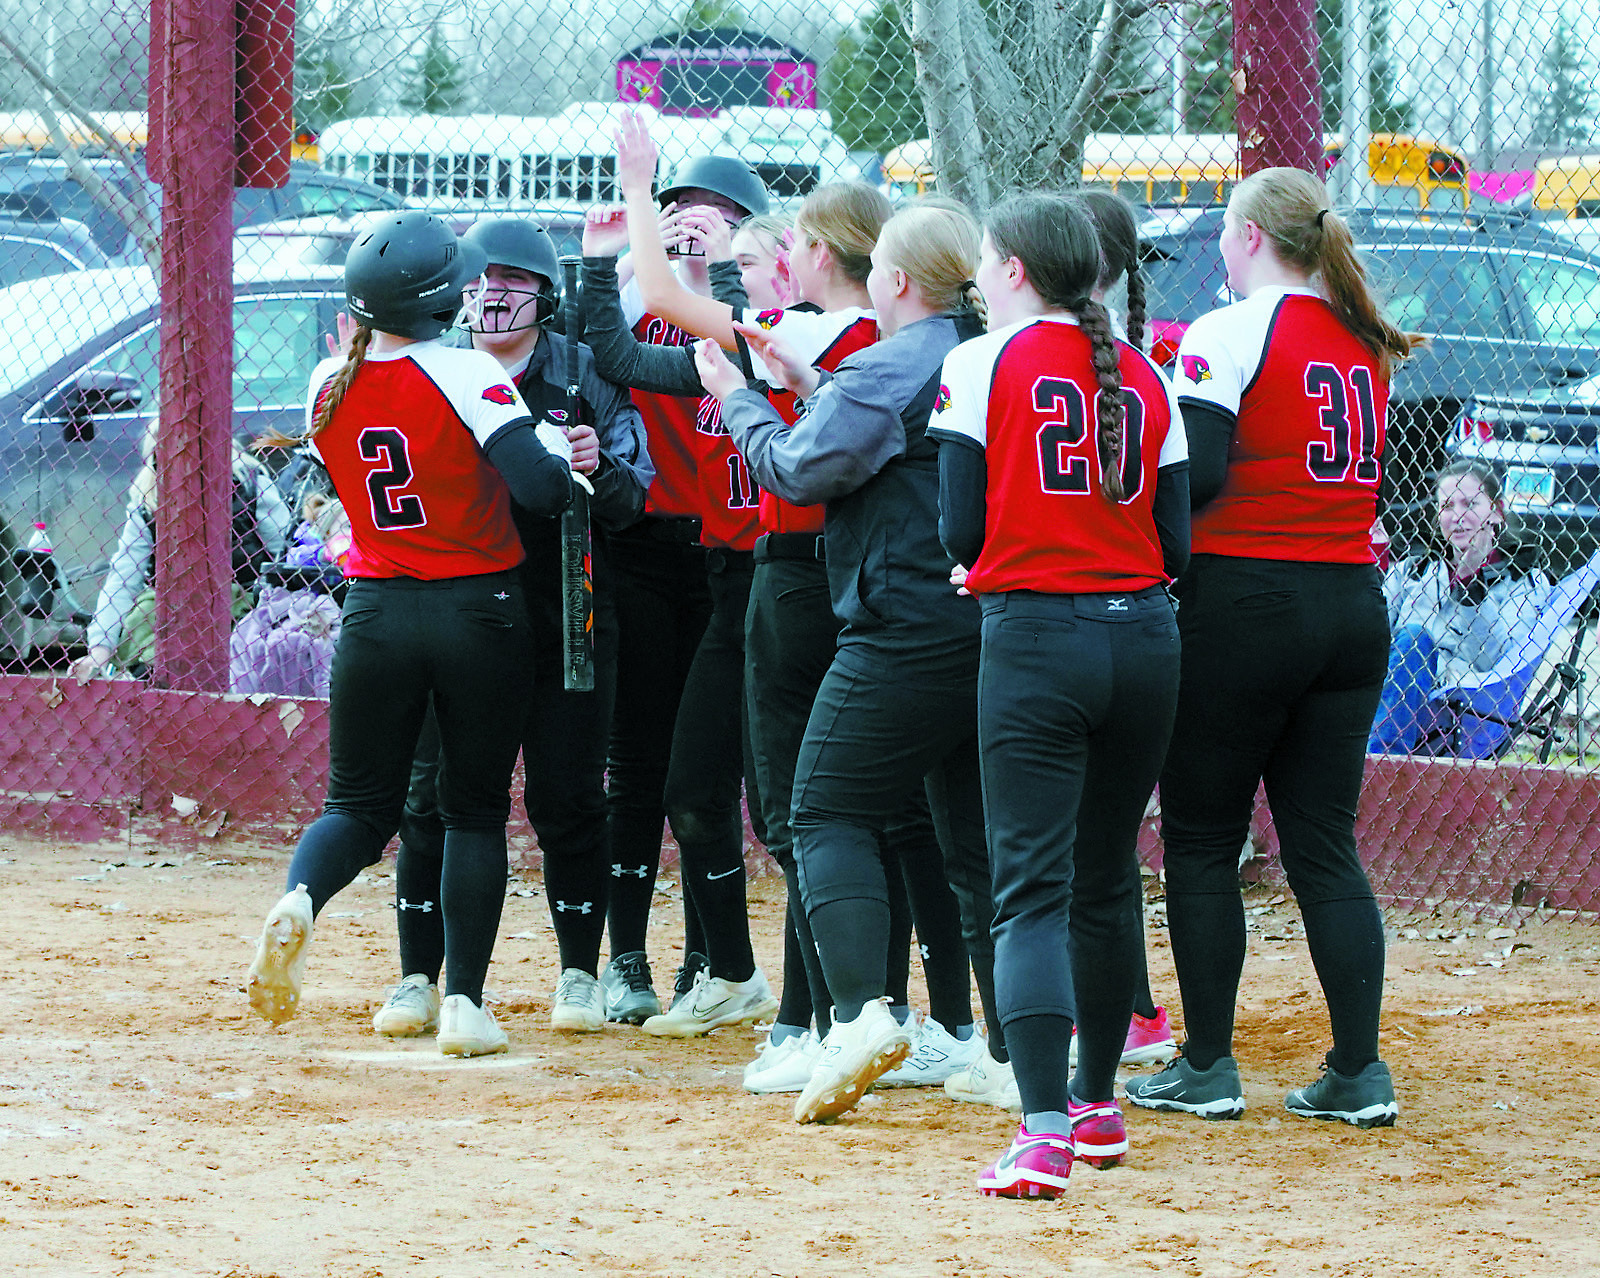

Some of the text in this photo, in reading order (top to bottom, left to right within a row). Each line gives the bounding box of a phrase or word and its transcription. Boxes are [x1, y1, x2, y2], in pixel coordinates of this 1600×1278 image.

[357, 426, 427, 531] 2
[1031, 375, 1146, 505] 20
[1304, 361, 1378, 482] 31
